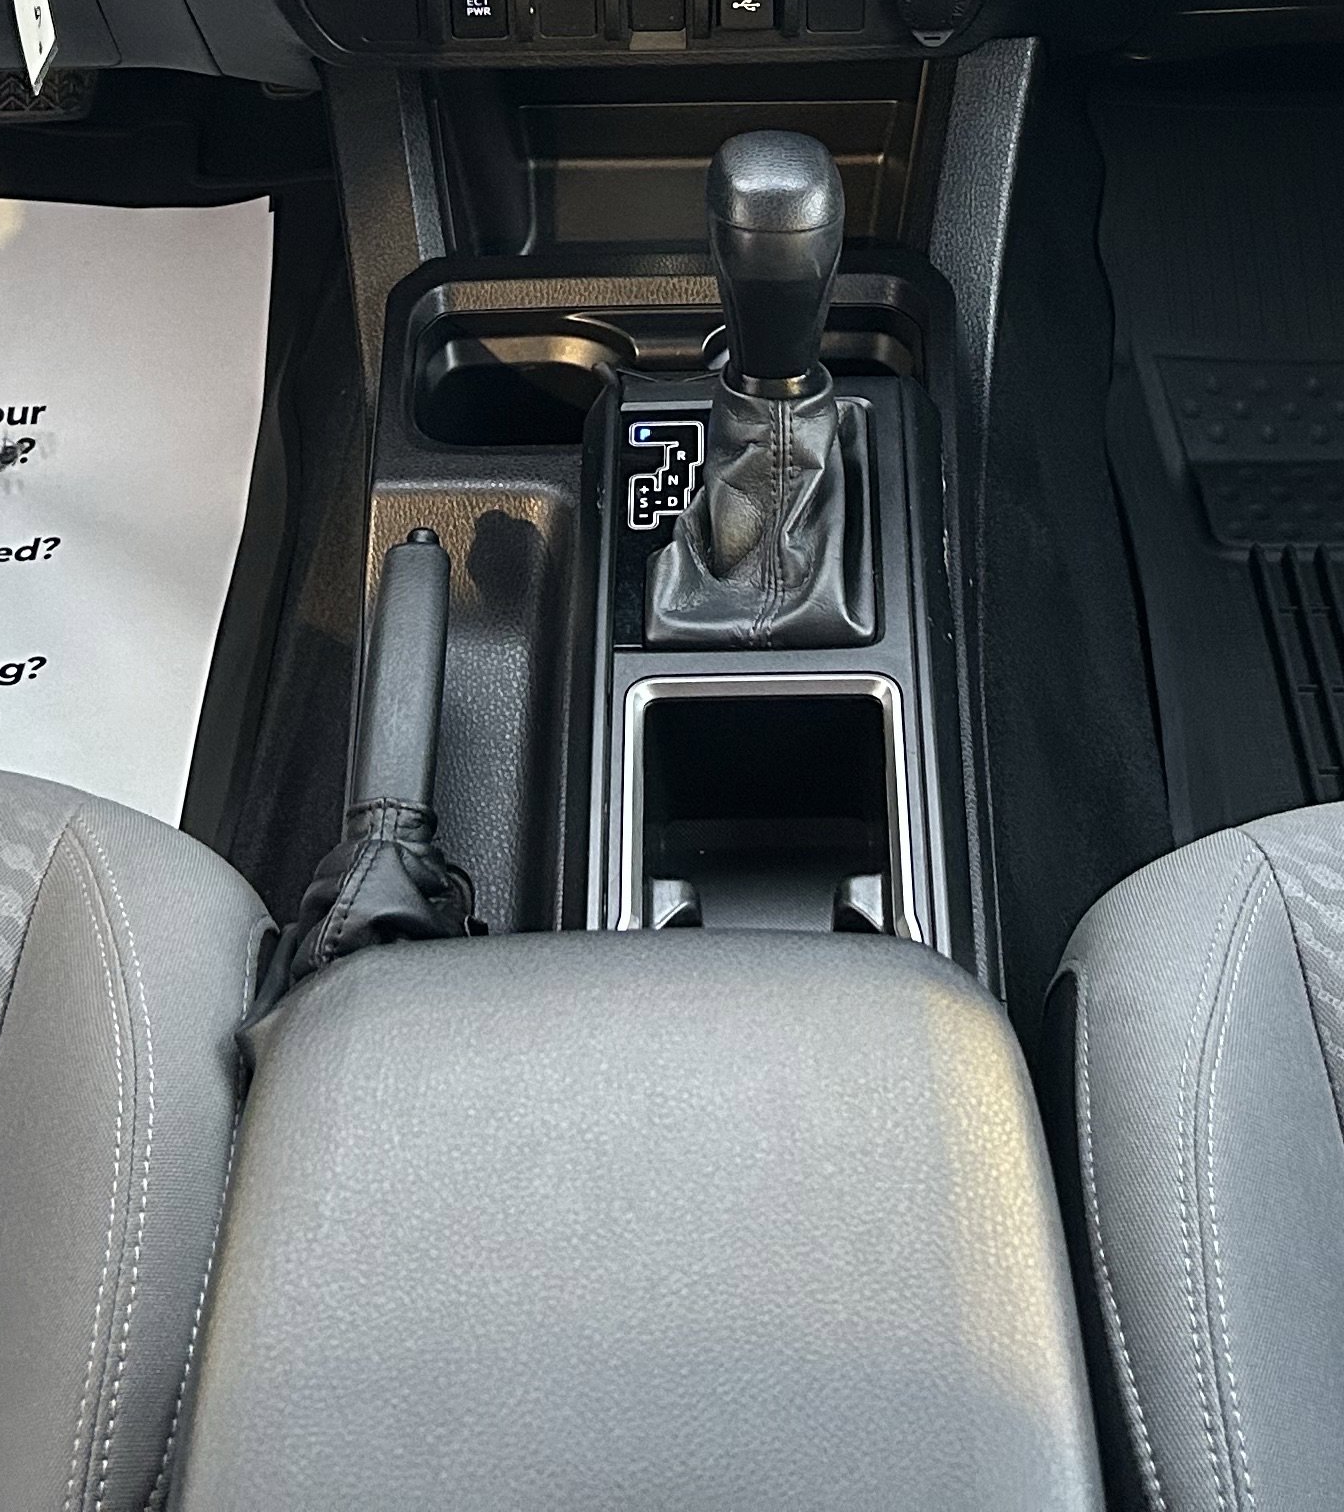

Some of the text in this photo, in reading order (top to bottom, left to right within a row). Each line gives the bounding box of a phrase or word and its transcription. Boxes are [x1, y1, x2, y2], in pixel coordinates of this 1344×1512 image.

[466, 6, 492, 16] PWR
[639, 428, 651, 440] P
[676, 450, 686, 461] R
[667, 474, 678, 486] N
[639, 497, 649, 508] S
[667, 496, 678, 507] D
